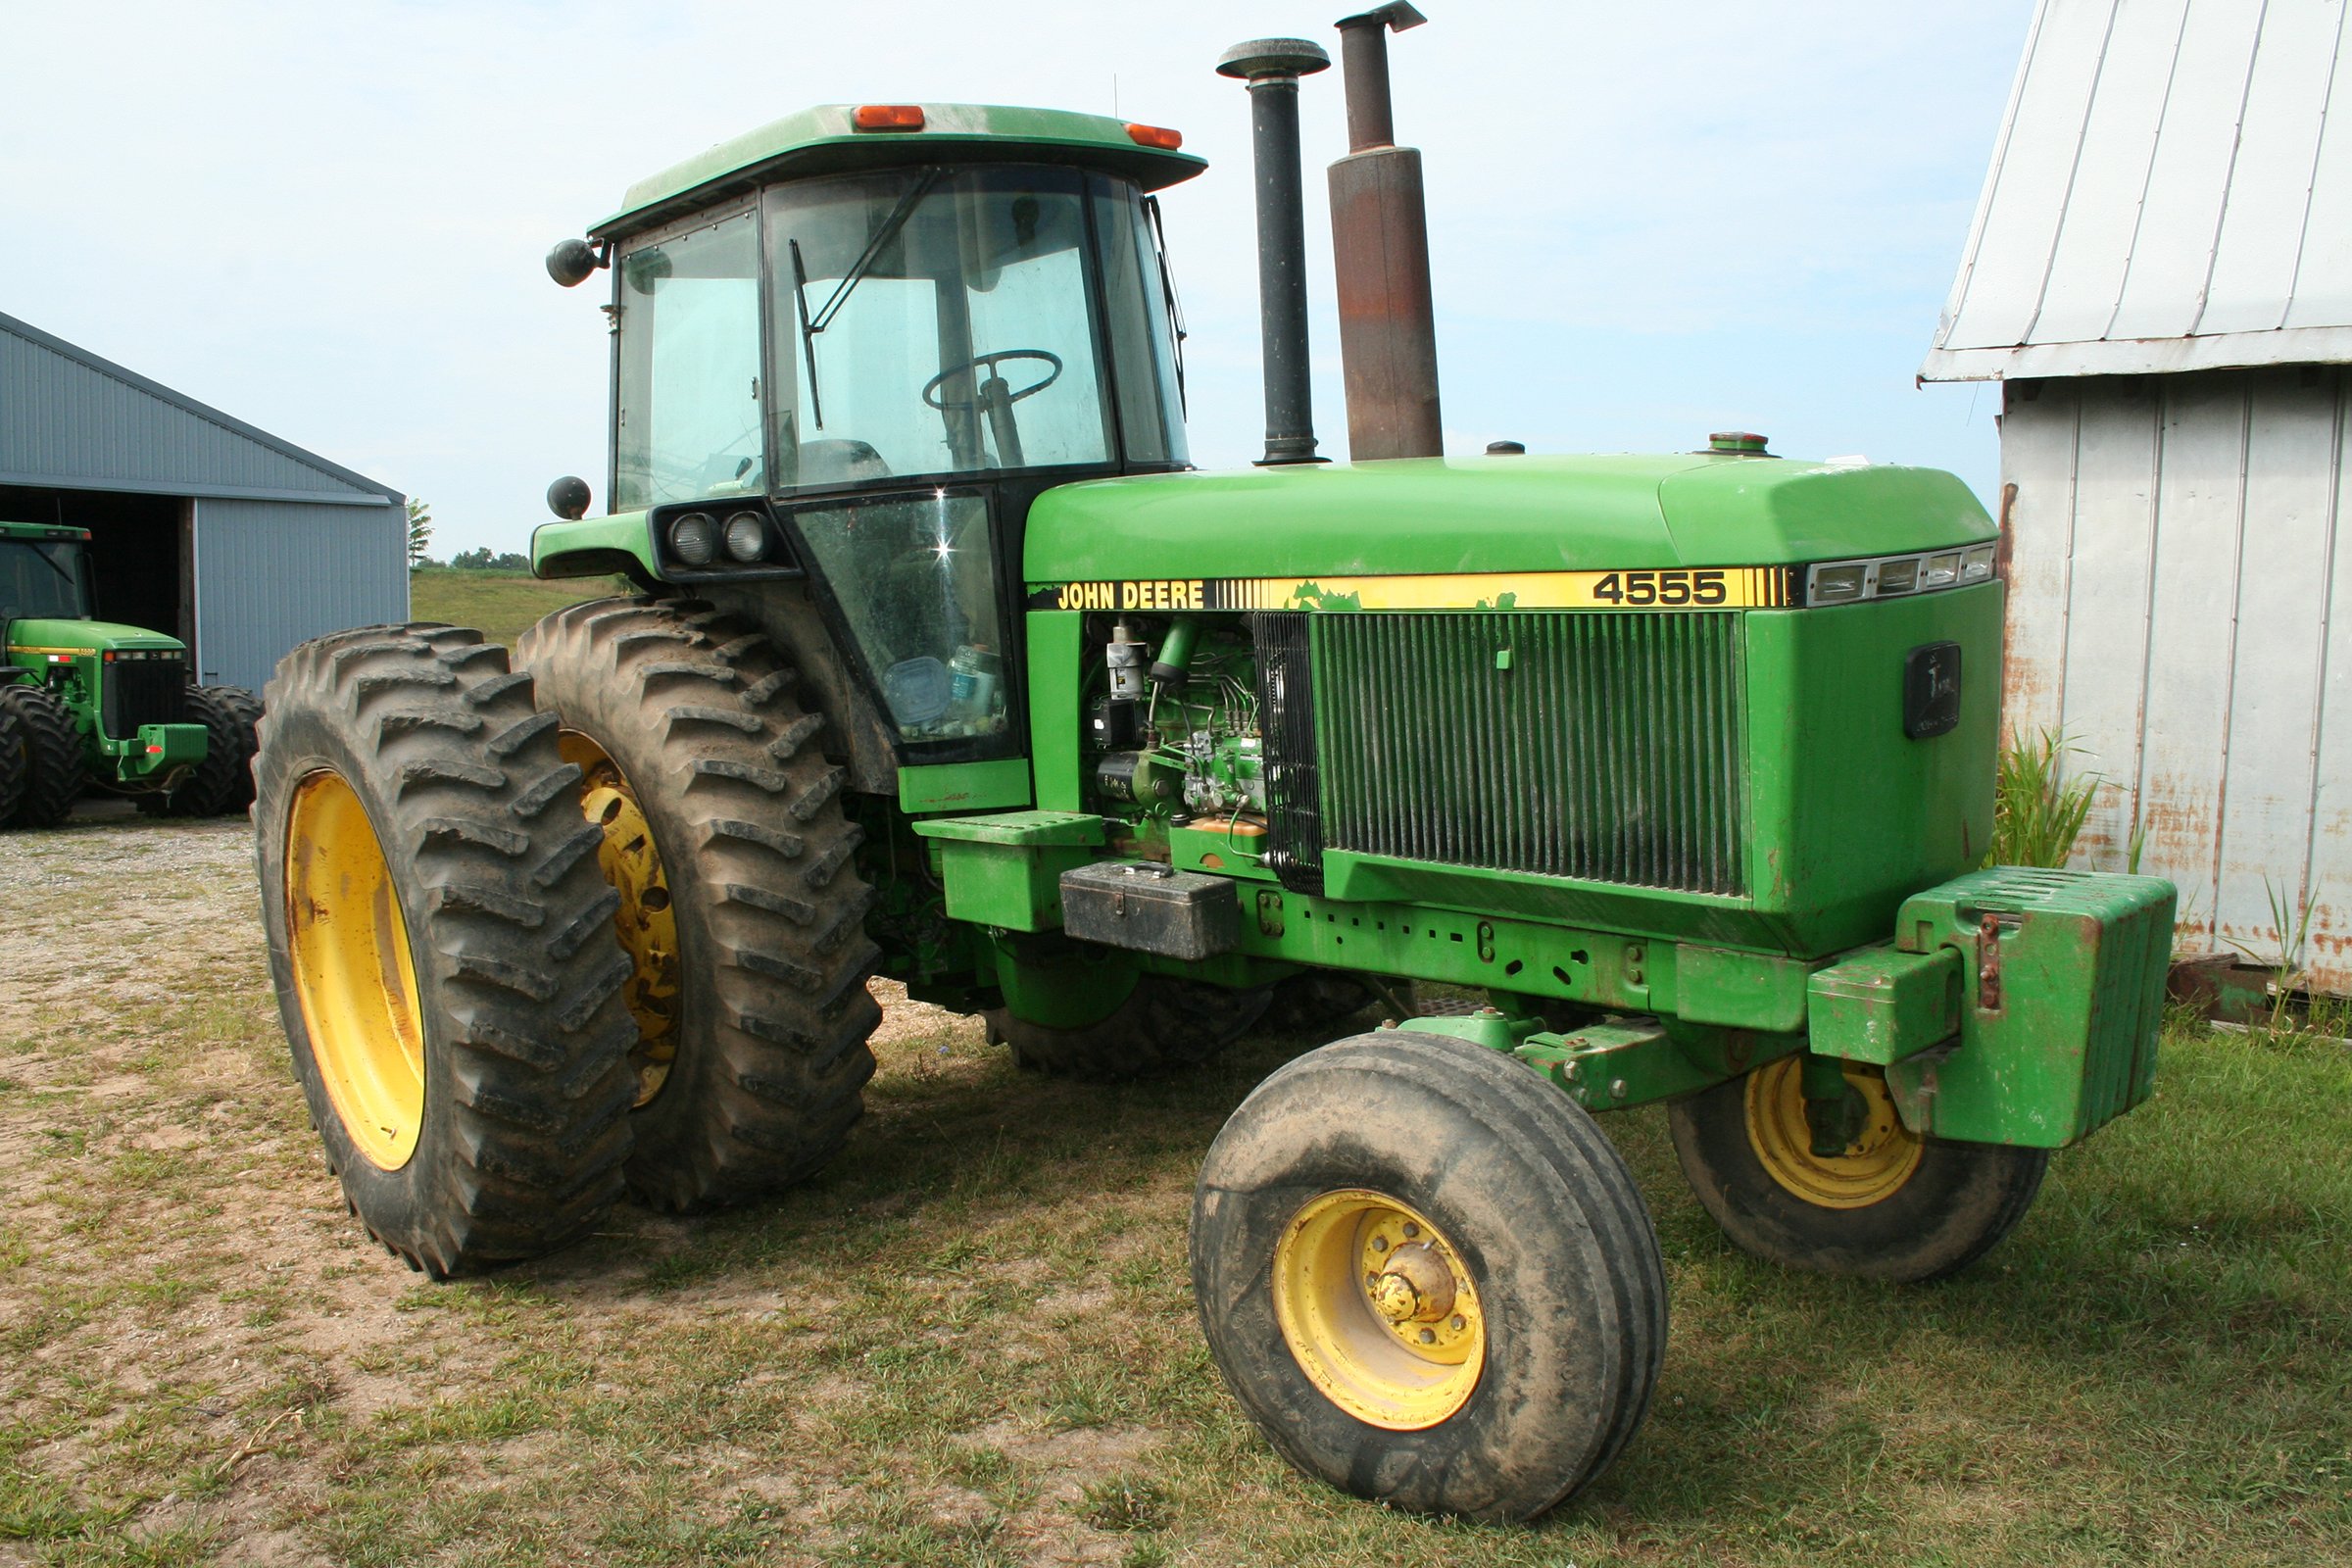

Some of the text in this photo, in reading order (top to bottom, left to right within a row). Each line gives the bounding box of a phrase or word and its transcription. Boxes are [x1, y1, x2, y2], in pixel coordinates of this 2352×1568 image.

[1058, 580, 1203, 610] JOHN DEERE
[1593, 571, 1726, 605] 4555
